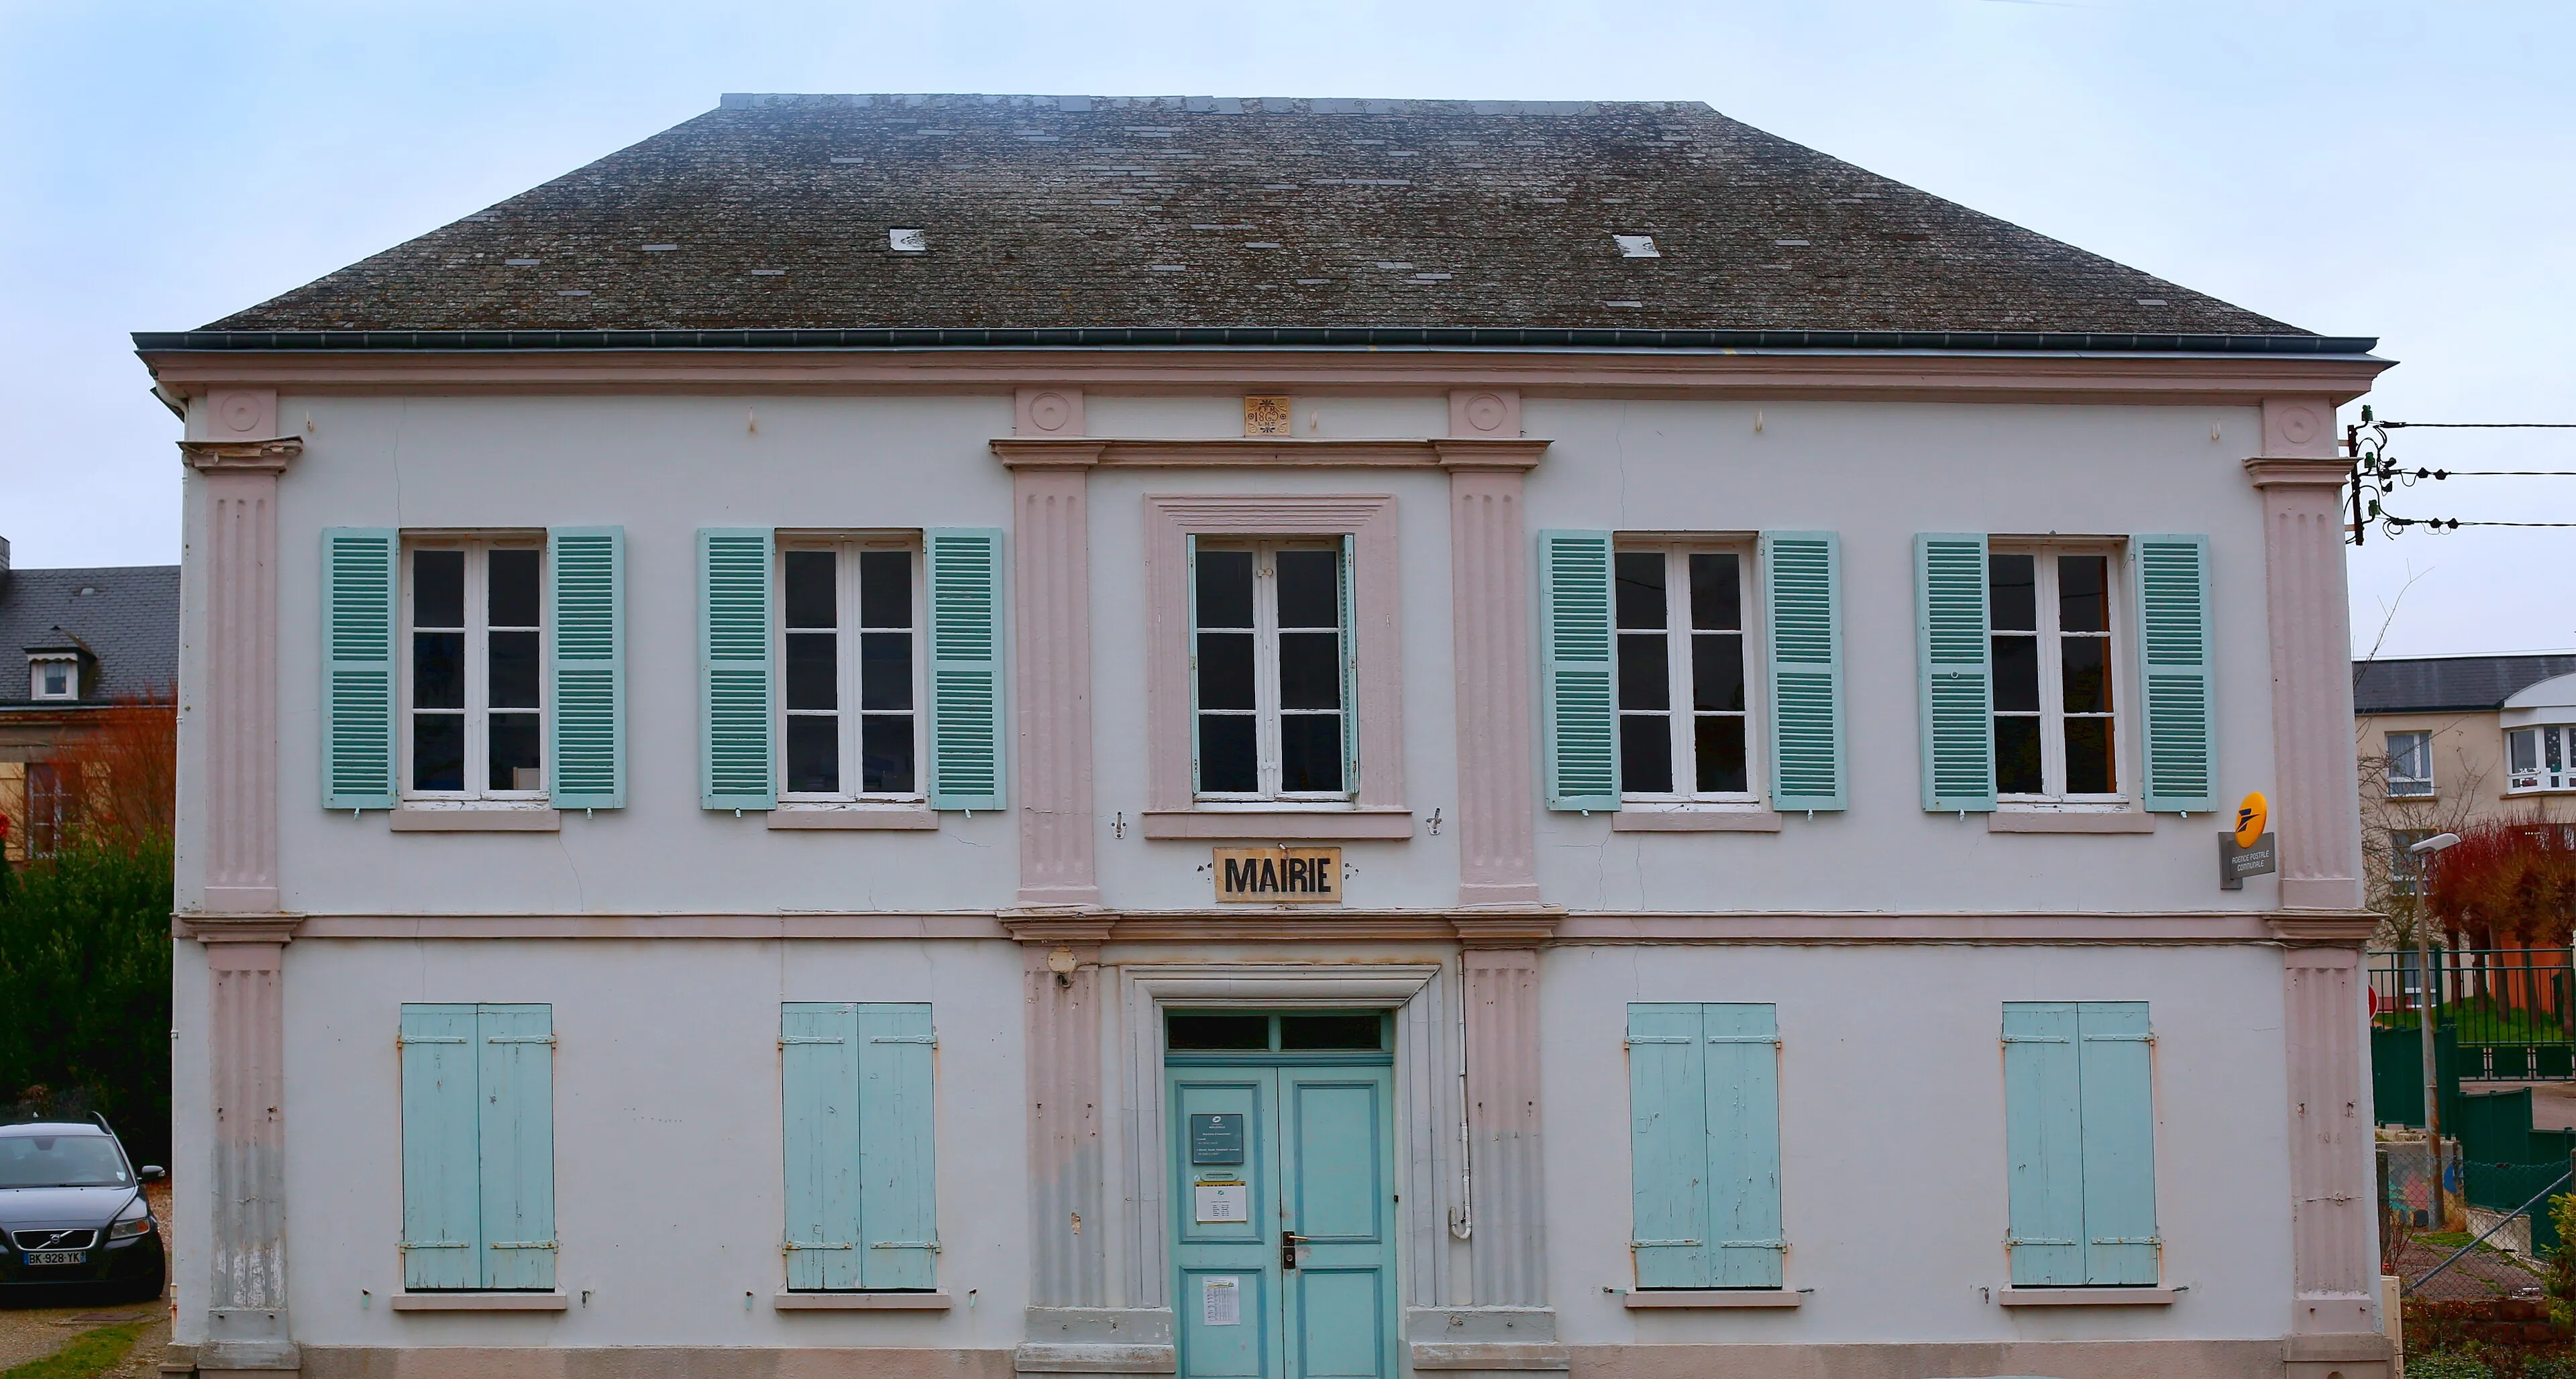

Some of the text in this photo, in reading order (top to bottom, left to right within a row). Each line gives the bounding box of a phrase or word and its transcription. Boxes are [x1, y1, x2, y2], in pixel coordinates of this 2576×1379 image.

[1255, 411, 1279, 422] 1869
[2232, 850, 2269, 864] AGENCE POSTALE
[2237, 859, 2264, 871] COMMUNALE
[1225, 858, 1331, 892] MAIRIE
